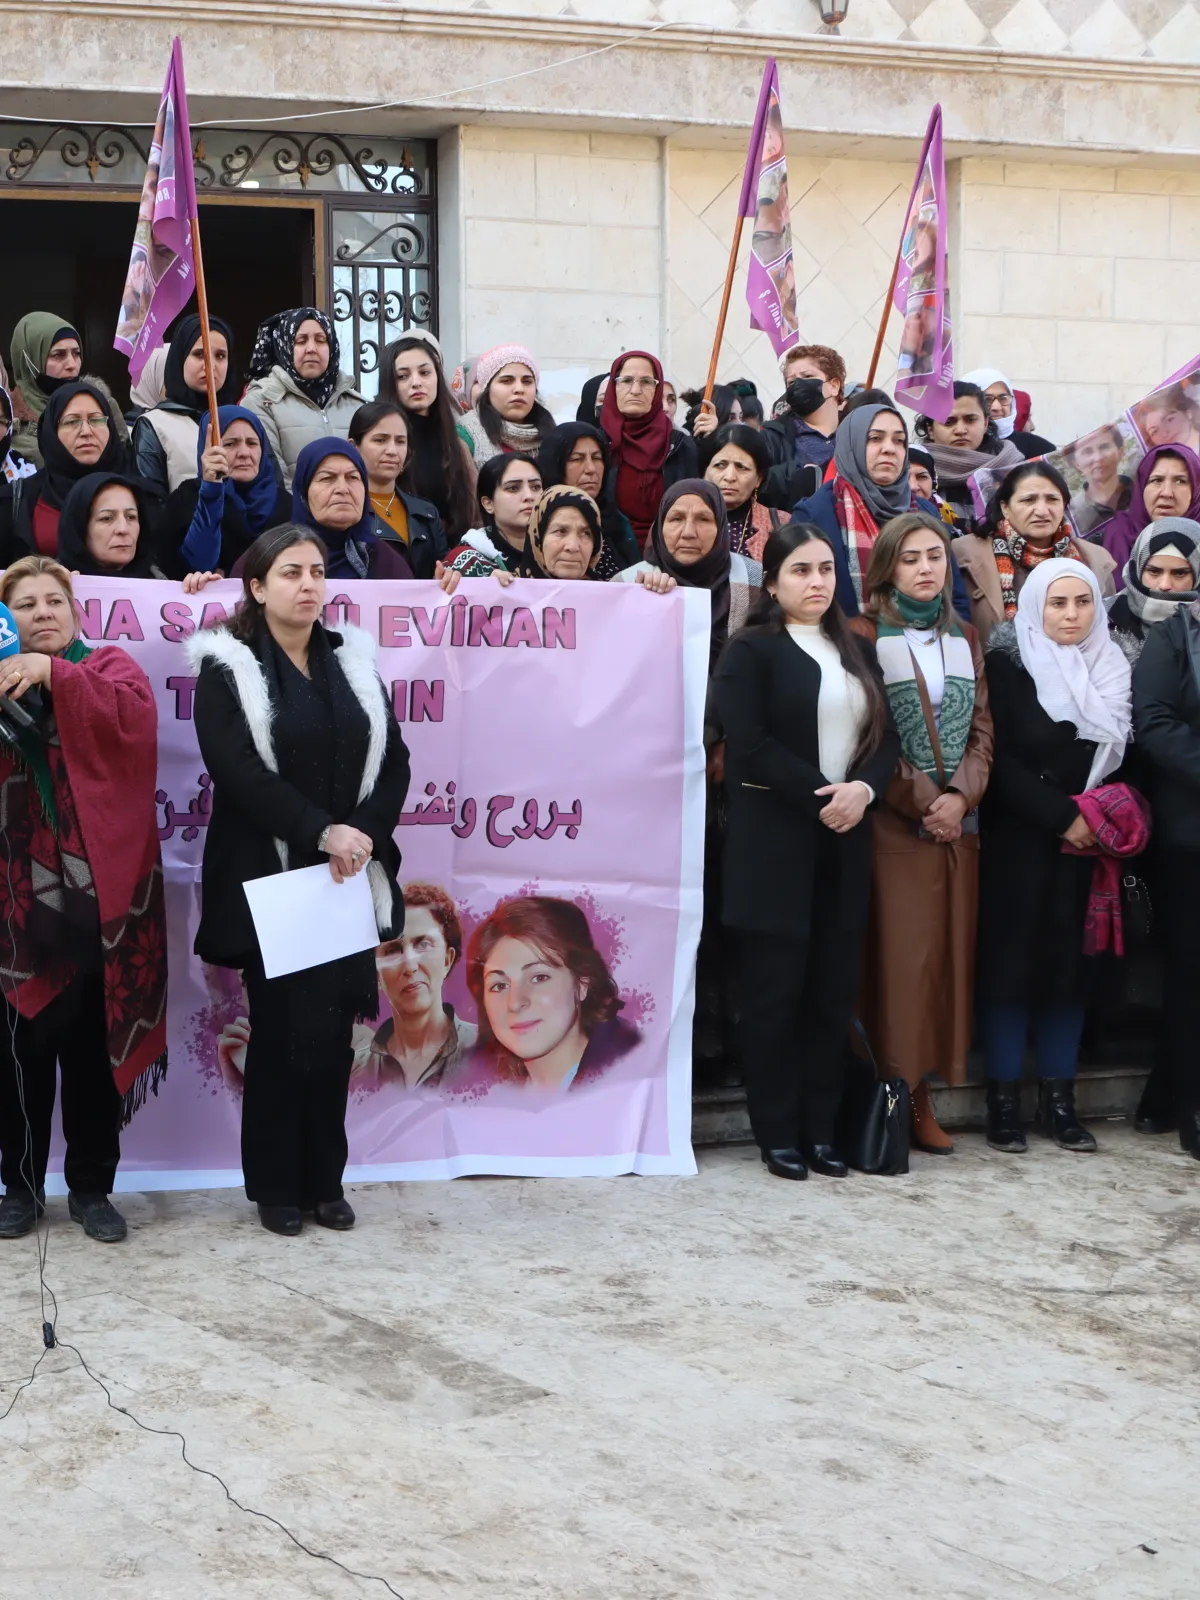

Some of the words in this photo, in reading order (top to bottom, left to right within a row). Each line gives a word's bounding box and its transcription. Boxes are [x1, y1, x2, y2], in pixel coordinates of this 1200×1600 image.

[767, 302, 781, 329] FÎDAN
[160, 601, 244, 643] SA
[379, 594, 577, 650] EVÎNAN
[486, 794, 583, 849] بروح
